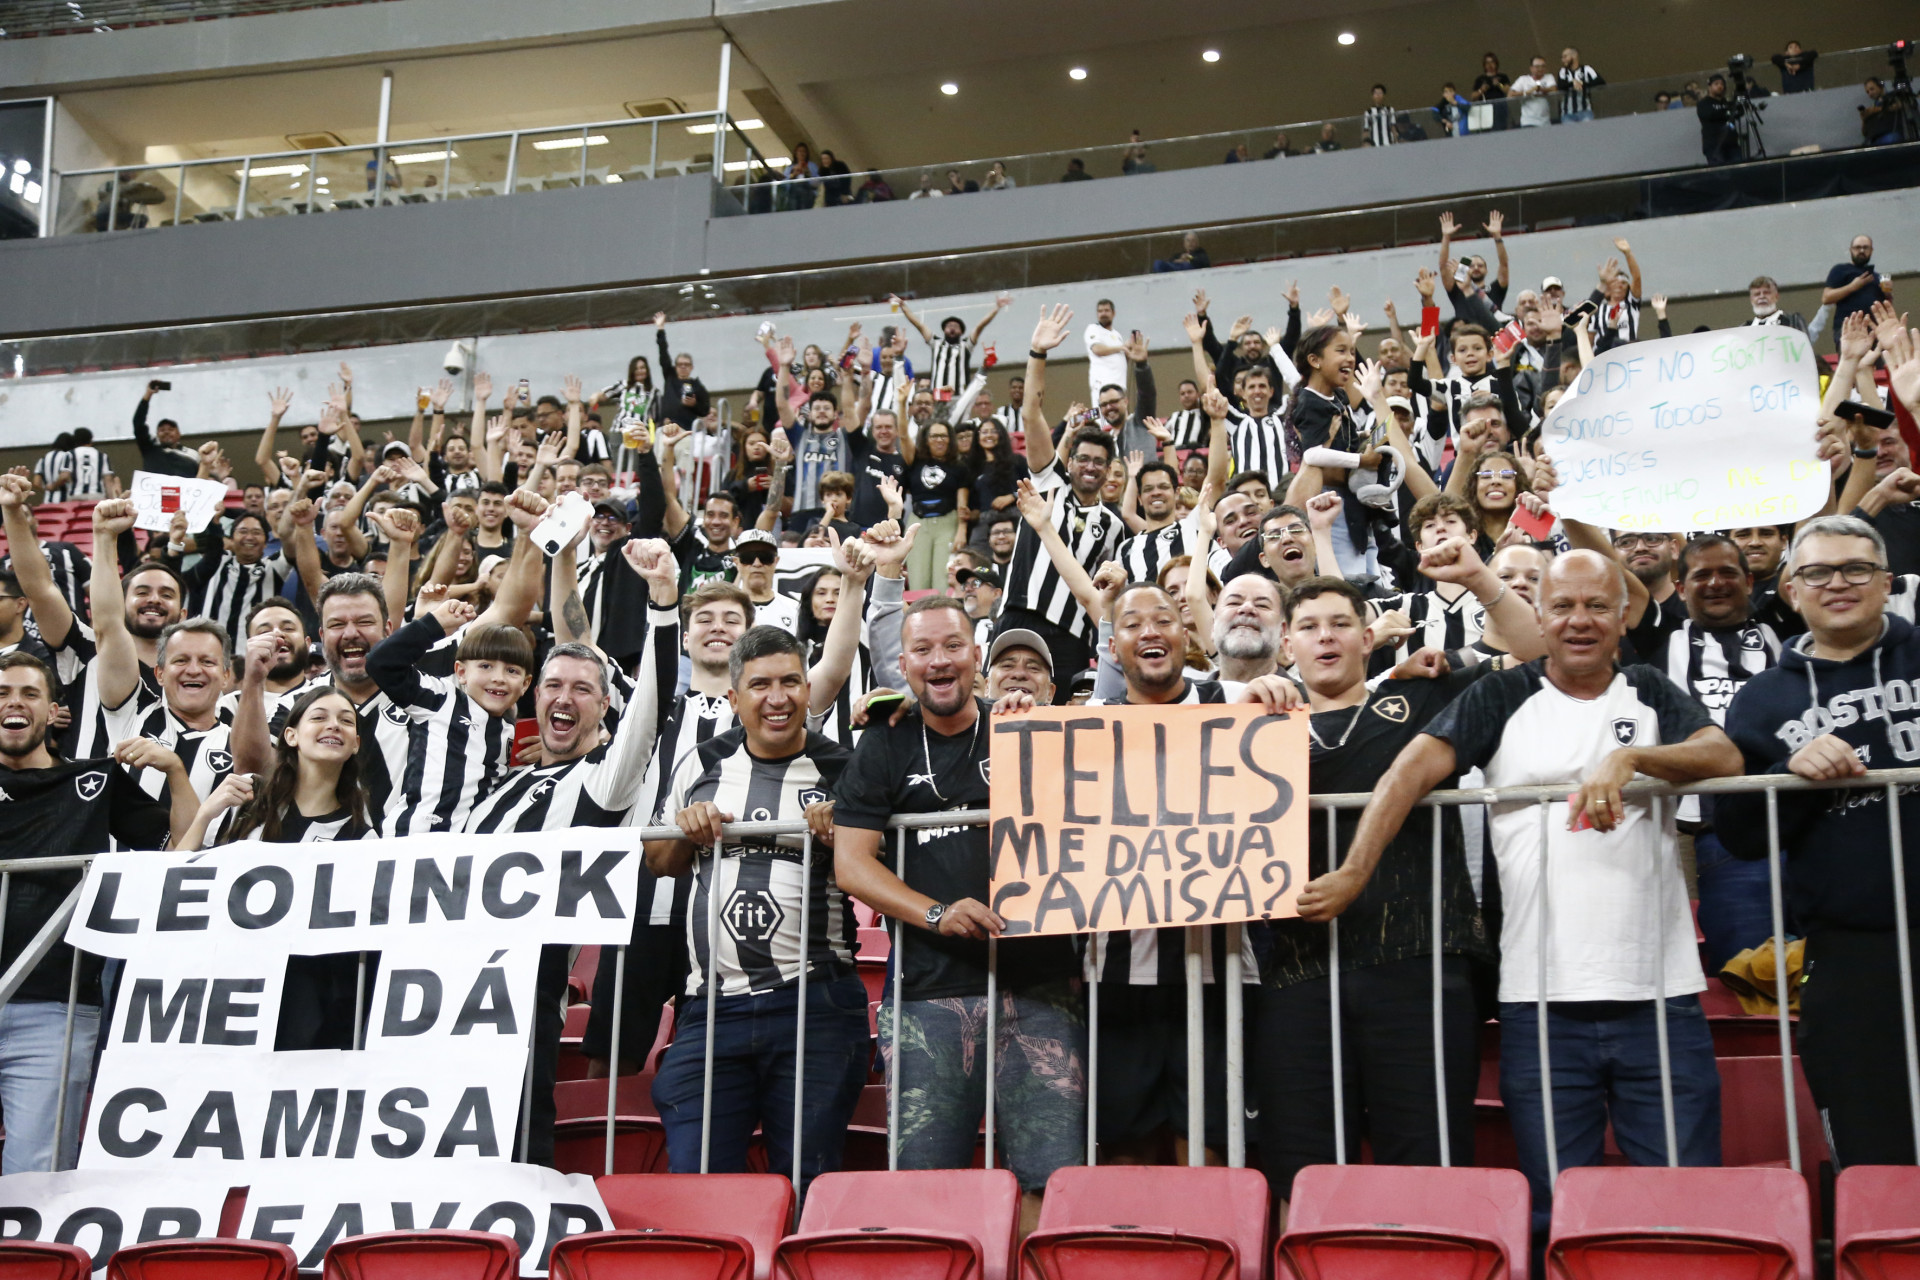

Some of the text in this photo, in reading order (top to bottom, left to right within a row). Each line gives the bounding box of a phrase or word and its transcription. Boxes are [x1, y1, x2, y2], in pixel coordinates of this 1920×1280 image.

[1659, 351, 1695, 382] NO
[1552, 379, 1801, 444] SOMOS TODOS BOTA
[1727, 466, 1769, 489] ME
[994, 713, 1294, 827] TELLES
[990, 816, 1085, 881] ME
[732, 902, 767, 928] fit
[991, 860, 1292, 936] CAMISA?
[121, 949, 518, 1046] ME DÁ
[97, 1086, 502, 1160] CAMISA
